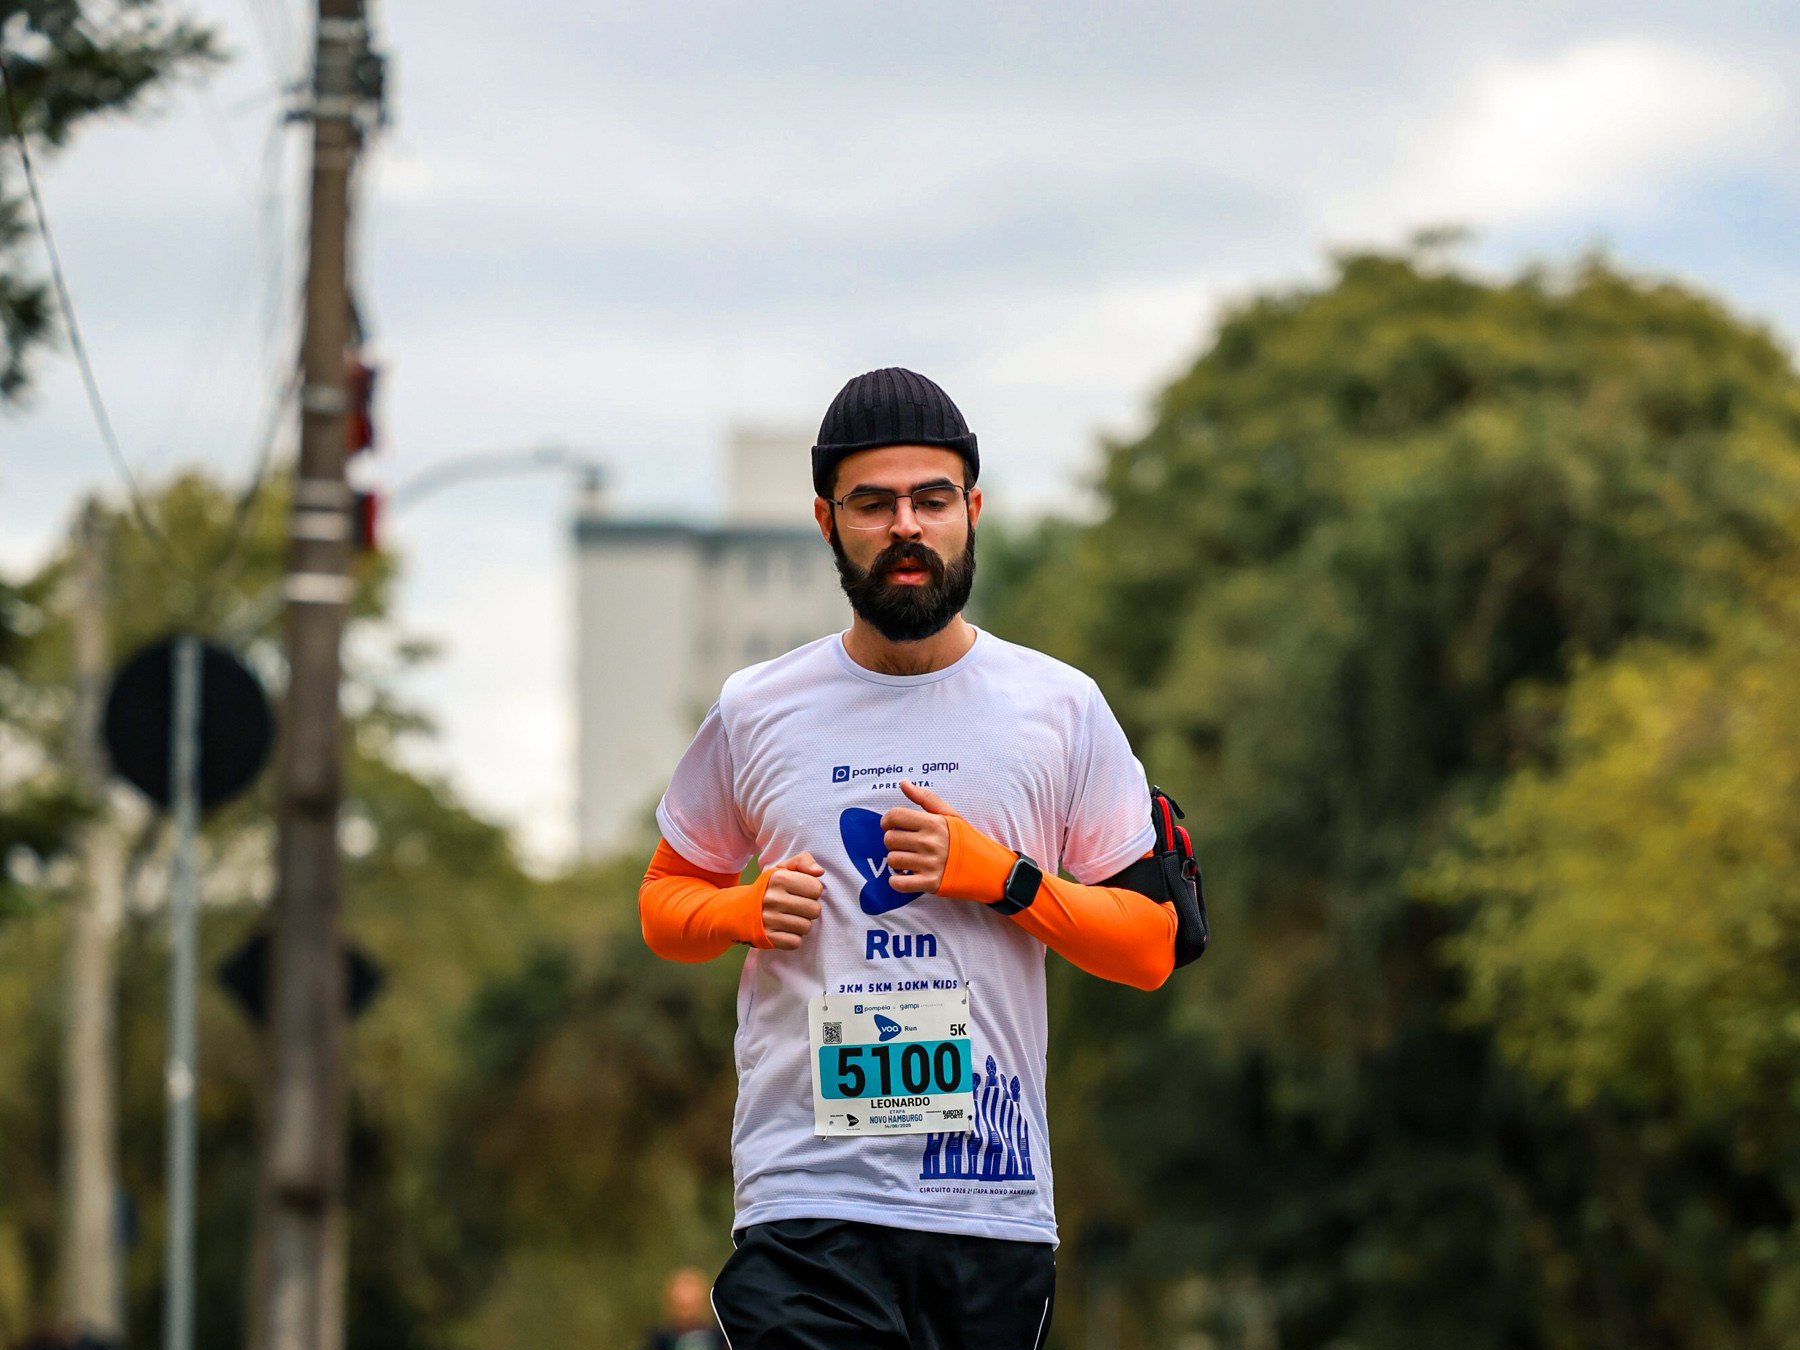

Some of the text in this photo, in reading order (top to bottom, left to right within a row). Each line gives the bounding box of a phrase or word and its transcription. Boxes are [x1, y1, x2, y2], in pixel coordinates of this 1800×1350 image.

[852, 764, 903, 778] pompéia
[922, 762, 959, 774] gampi
[865, 929, 937, 960] Run
[839, 980, 958, 993] 3KM 5KM 10KM KIDS
[881, 1025, 899, 1033] voa
[950, 1023, 967, 1036] 5K
[838, 1042, 961, 1097] 5100
[870, 1096, 930, 1109] LEONARDO
[869, 1116, 887, 1124] NOVO
[888, 1113, 923, 1124] HAMBURGO
